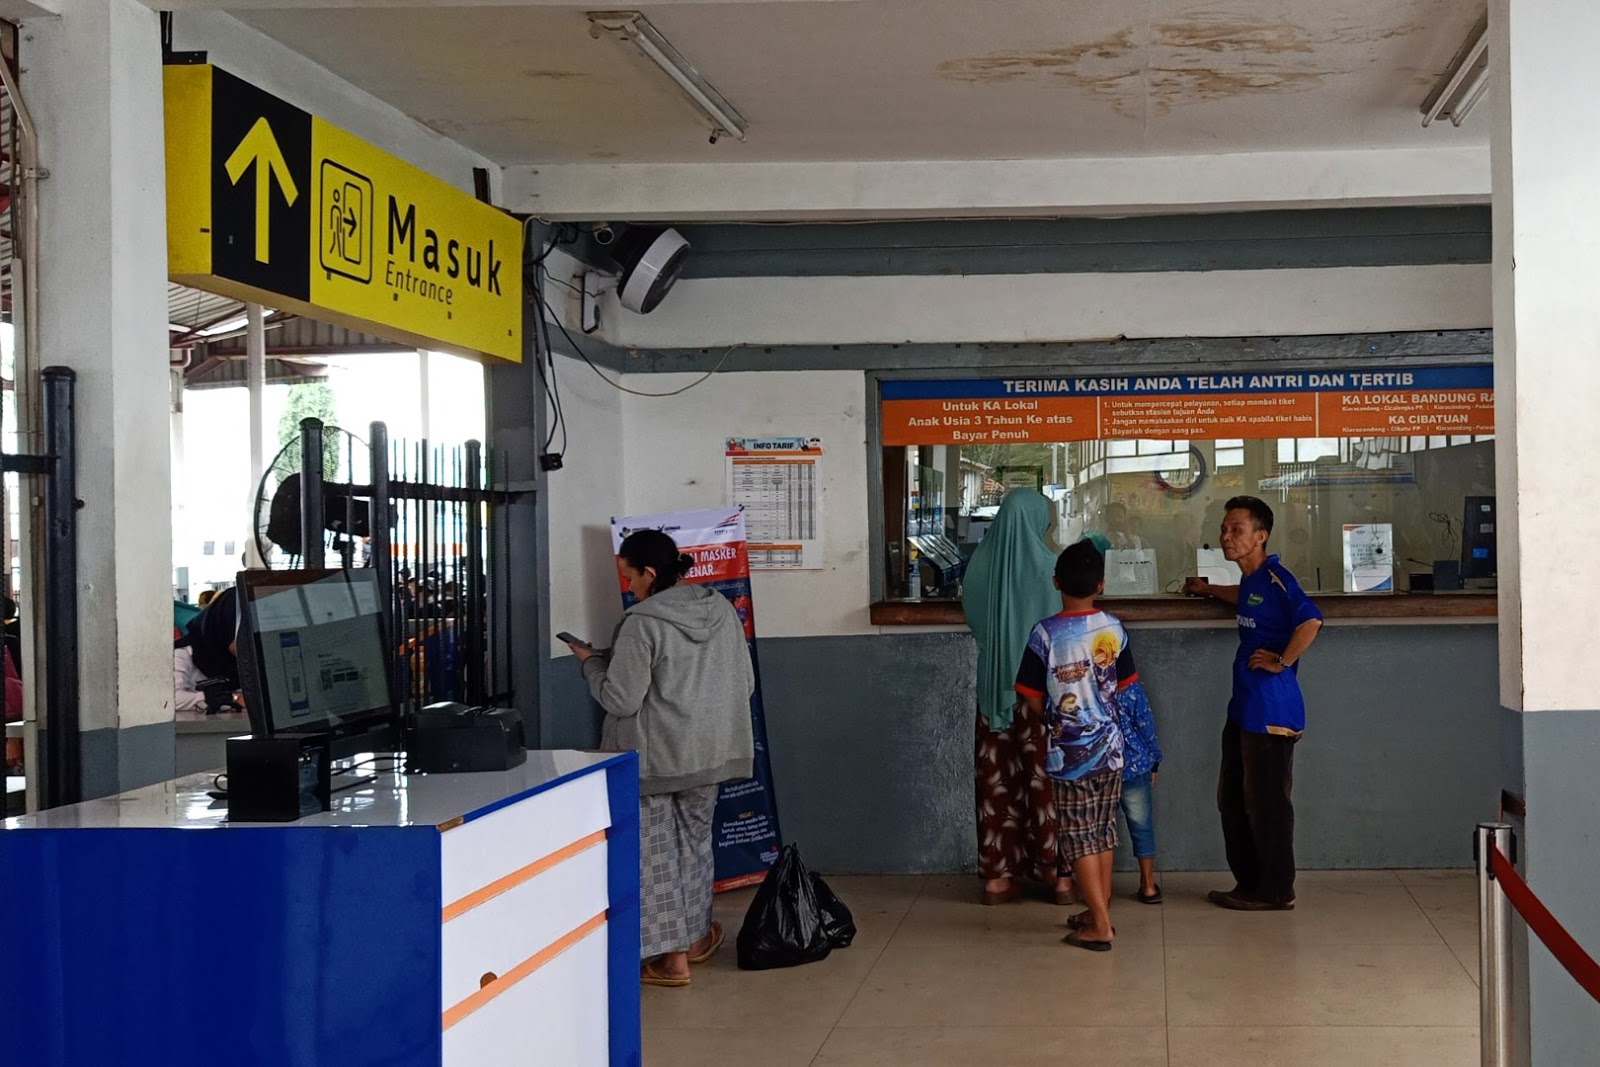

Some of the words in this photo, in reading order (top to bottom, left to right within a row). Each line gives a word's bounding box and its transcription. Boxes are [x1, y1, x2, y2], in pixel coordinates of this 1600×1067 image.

[387, 194, 502, 297] Masuk
[385, 260, 454, 306] Entrance
[1003, 380, 1070, 393] TERIMA
[1075, 378, 1129, 391] KASIH
[1134, 377, 1182, 390] ANDA
[1187, 376, 1244, 389] TELAH
[1249, 374, 1303, 388] ANTRI
[1308, 373, 1345, 387] DAN
[1350, 372, 1414, 386] TERTIB
[1134, 400, 1182, 410] mempercepat
[1184, 399, 1222, 408] pelayanan,
[1223, 399, 1246, 407] setiap
[1247, 398, 1278, 406] membeli
[1342, 395, 1361, 405] KA
[1364, 394, 1408, 404] LOKAL
[1411, 393, 1476, 403] BANDUNG
[942, 402, 979, 411] Untuk
[983, 401, 1002, 411] KA
[1004, 400, 1038, 410] Lokal
[1112, 409, 1145, 417] sebutkan
[1145, 408, 1172, 416] stasiun
[1173, 408, 1195, 416] tujuan
[1197, 407, 1215, 415] Anda
[908, 417, 940, 426] Anak
[943, 416, 971, 426] Usia
[974, 415, 982, 425] 3
[985, 415, 1023, 425] Tahun
[1026, 414, 1043, 424] Ke
[1046, 414, 1073, 424] atas
[1112, 418, 1136, 427] Jangan
[1138, 417, 1183, 425] memaksakan
[1185, 416, 1198, 424] diri
[1198, 416, 1218, 424] untuk
[1236, 415, 1247, 423] KA
[1248, 415, 1274, 424] apabila
[1275, 414, 1292, 422] tiket
[1293, 414, 1313, 422] habis
[1388, 415, 1406, 424] KA
[1408, 413, 1469, 424] CIBATUAN
[952, 430, 988, 442] Bayar
[991, 429, 1029, 439] Penuh
[1112, 427, 1142, 437] Bayarlah
[1144, 427, 1170, 436] dengan
[1172, 427, 1189, 435] uang
[753, 442, 771, 450] INFO
[772, 442, 795, 450] TARIF
[700, 547, 737, 563] MASKER
